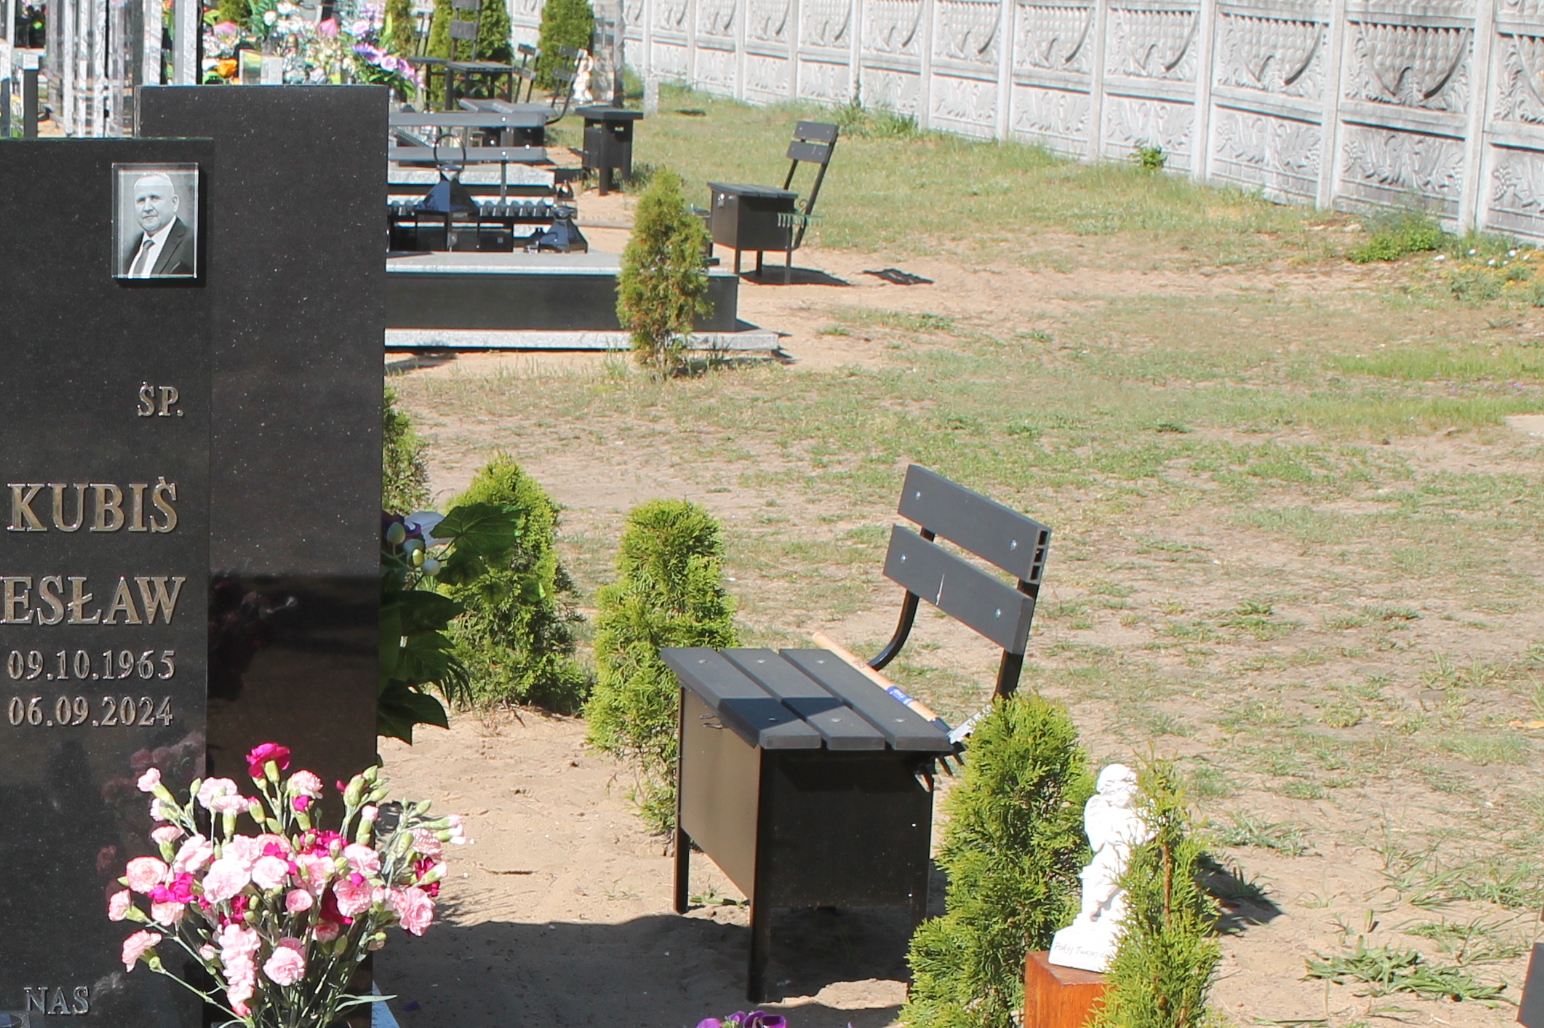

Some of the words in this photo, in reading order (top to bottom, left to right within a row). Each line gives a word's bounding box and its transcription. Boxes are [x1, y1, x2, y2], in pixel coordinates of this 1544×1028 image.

[6, 476, 179, 533] KUBIŚ
[7, 649, 176, 681] 09.10.1965
[7, 695, 174, 727] 06.09.2024
[23, 985, 91, 1017] NAS
